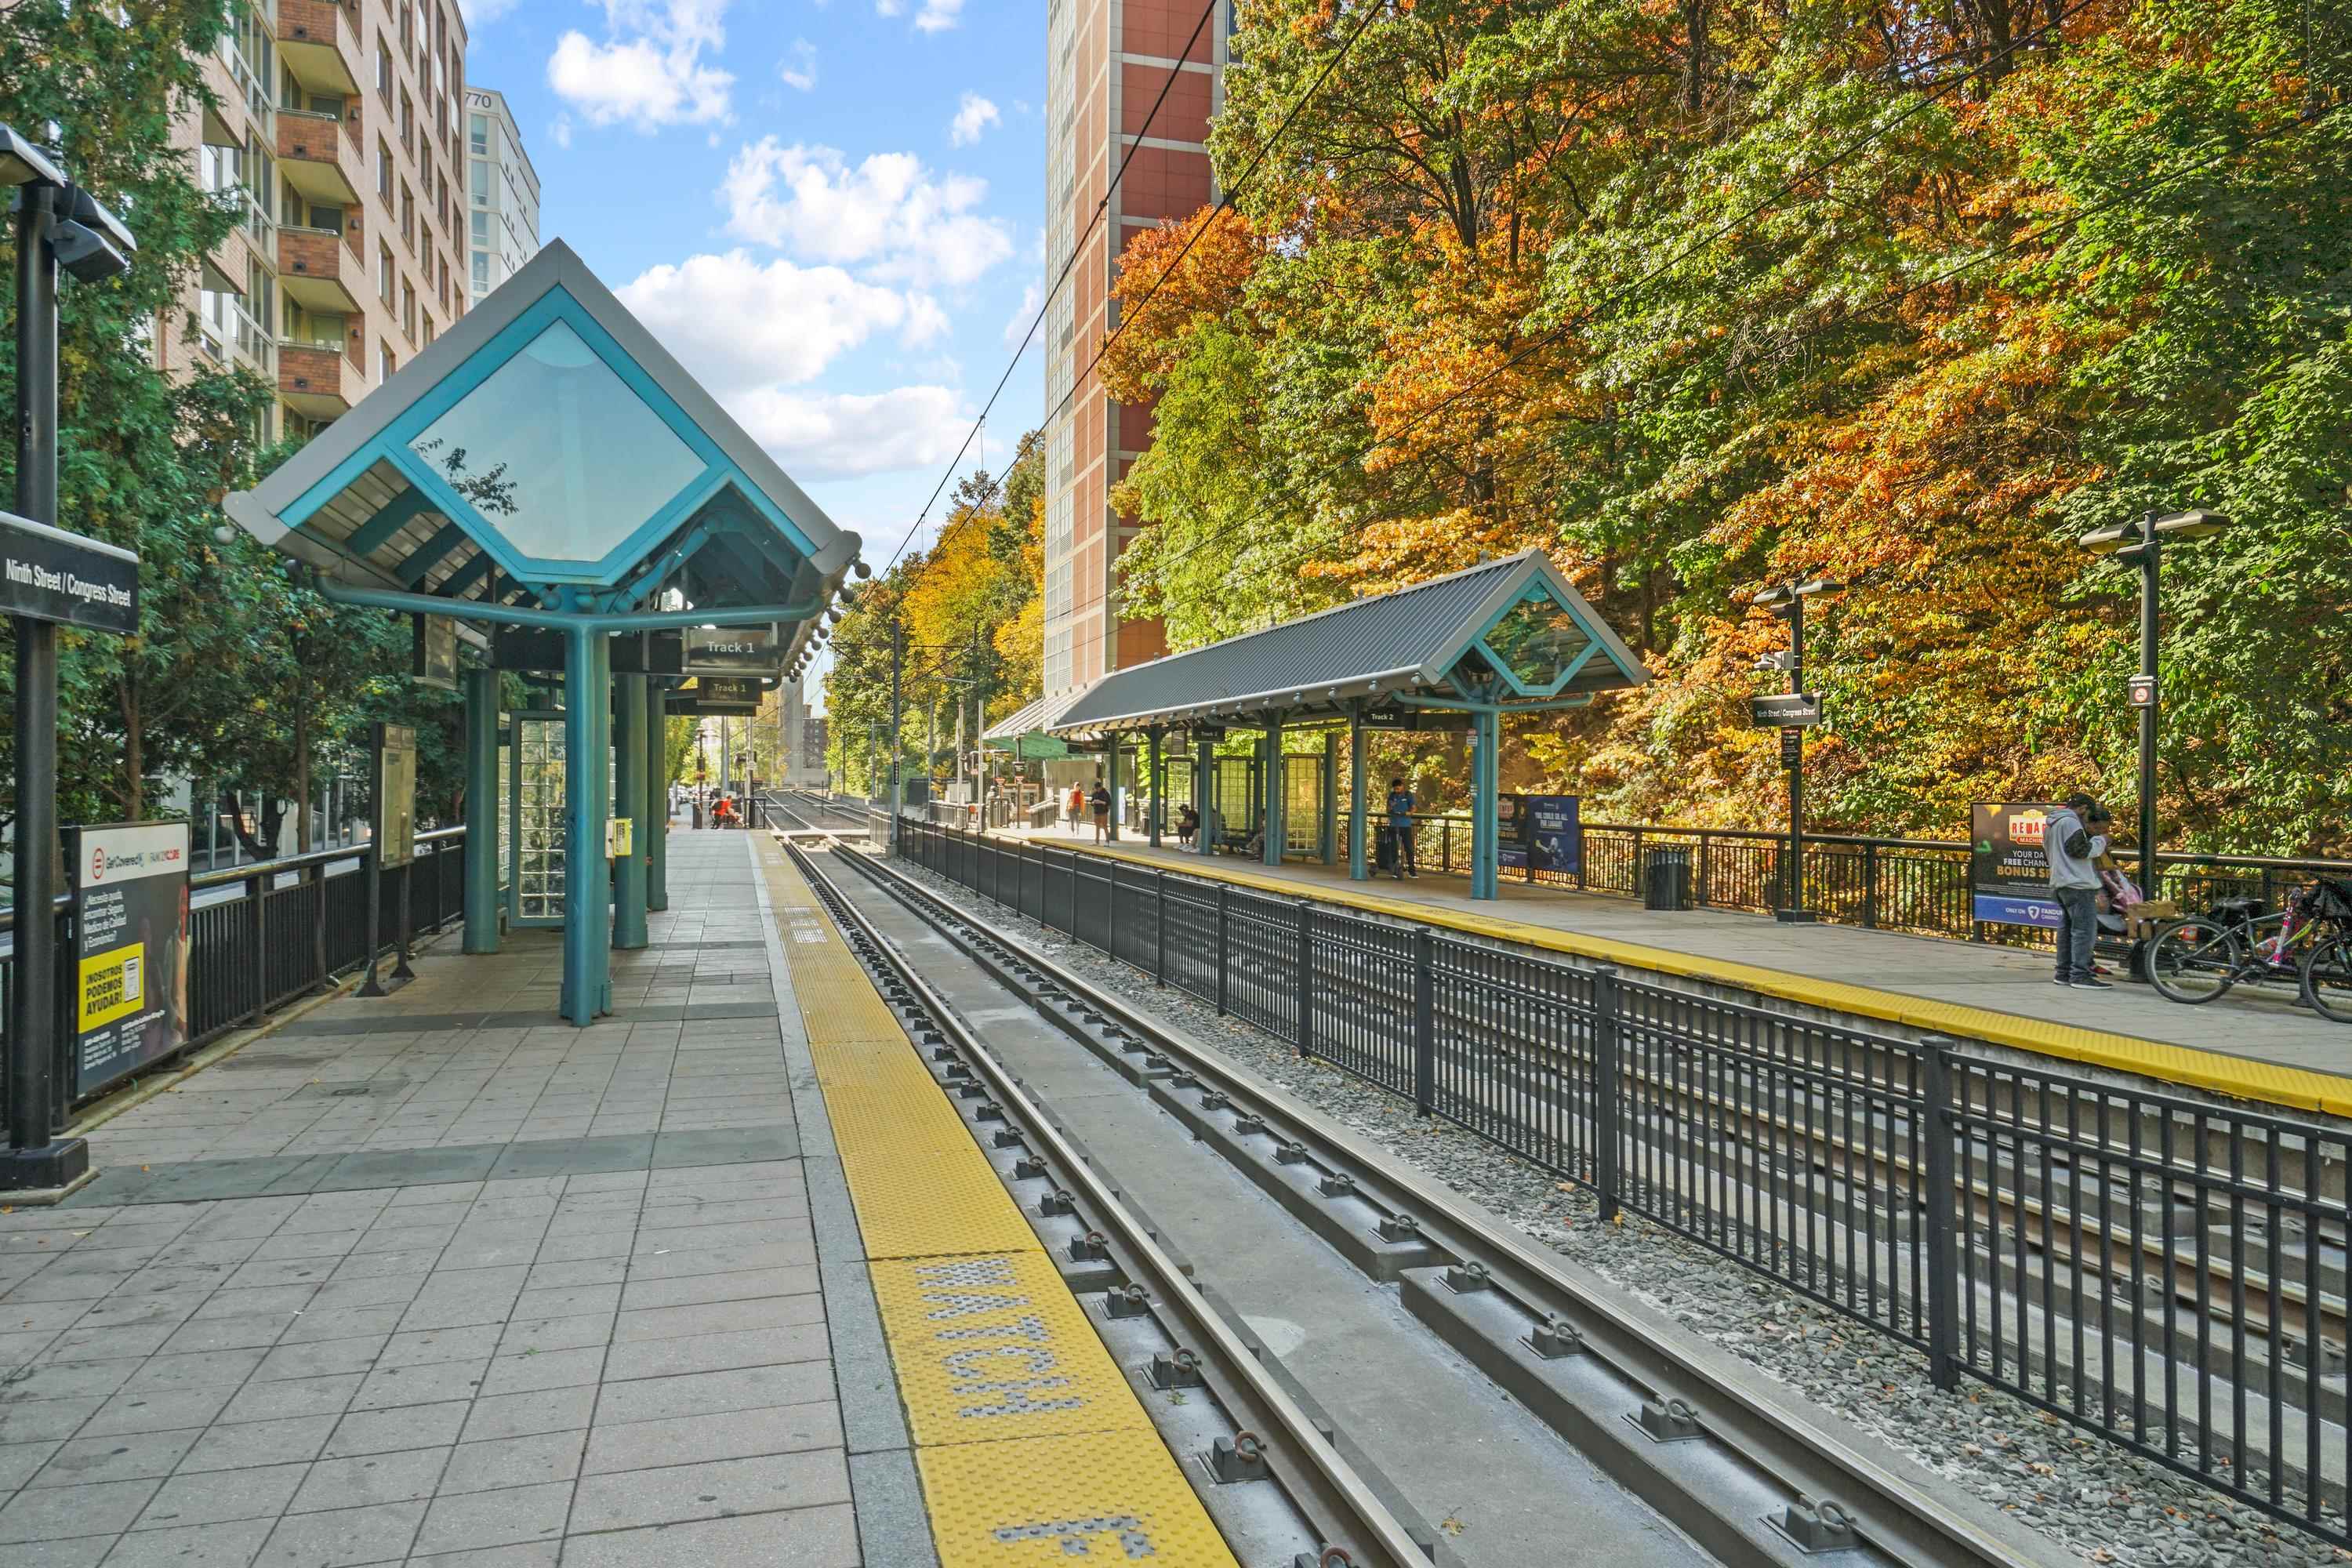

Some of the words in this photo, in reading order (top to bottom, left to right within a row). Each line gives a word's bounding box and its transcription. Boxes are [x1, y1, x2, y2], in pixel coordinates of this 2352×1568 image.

[6, 558, 32, 584] Ninth
[34, 564, 61, 591] Street
[62, 572, 66, 593] /
[67, 574, 107, 602] Congress
[107, 584, 131, 607] Street
[707, 641, 742, 653] Track
[747, 642, 754, 653] 1
[713, 683, 738, 692] Track
[2013, 850, 2033, 858] YOUR
[2003, 858, 2022, 866] FREE
[2023, 858, 2050, 867] CHANC
[1997, 866, 2036, 877] BONUS
[86, 977, 122, 1000] PODEMOS
[85, 991, 122, 1016] AYUDAR!
[915, 1258, 1088, 1418] WATCH
